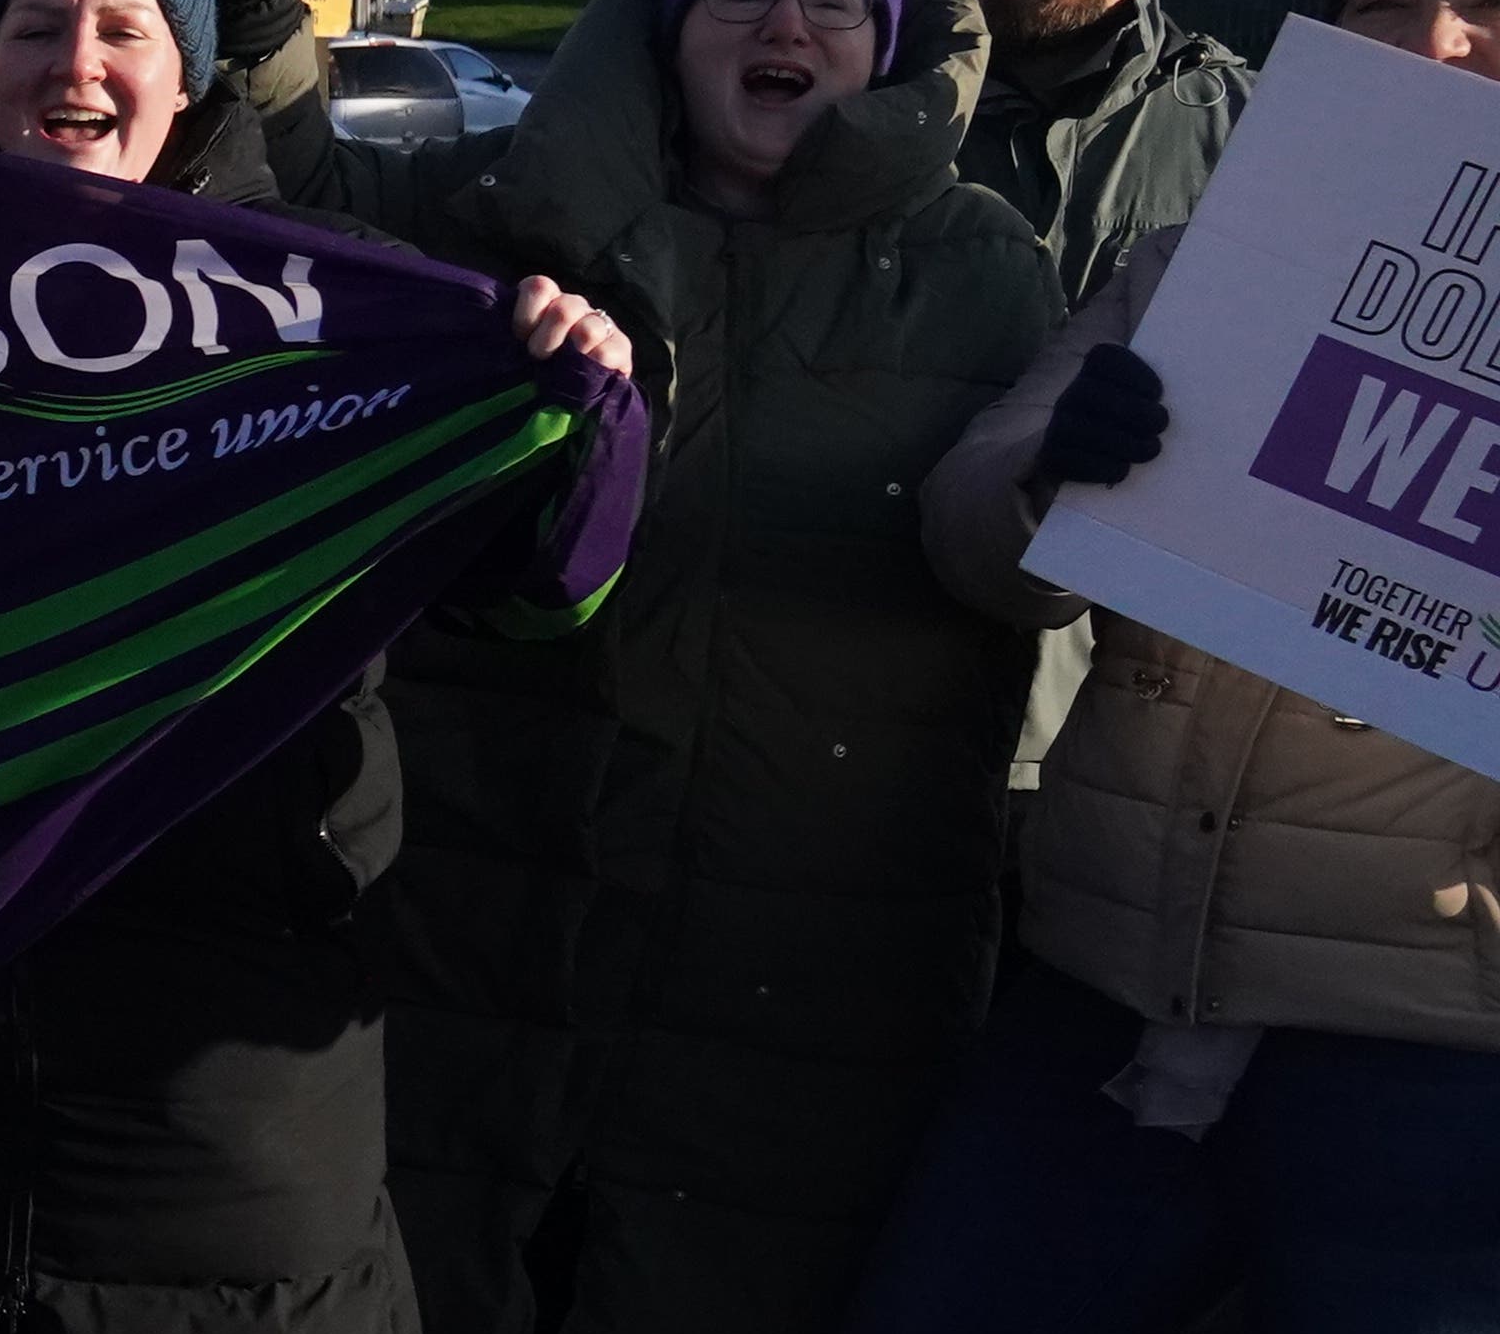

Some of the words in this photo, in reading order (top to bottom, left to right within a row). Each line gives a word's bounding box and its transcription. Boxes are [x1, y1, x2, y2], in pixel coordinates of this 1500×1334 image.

[210, 383, 411, 460] union
[1324, 373, 1500, 545] WE
[1312, 592, 1371, 644] WE
[1365, 617, 1456, 680] RISE
[1331, 559, 1473, 641] TOGETHER
